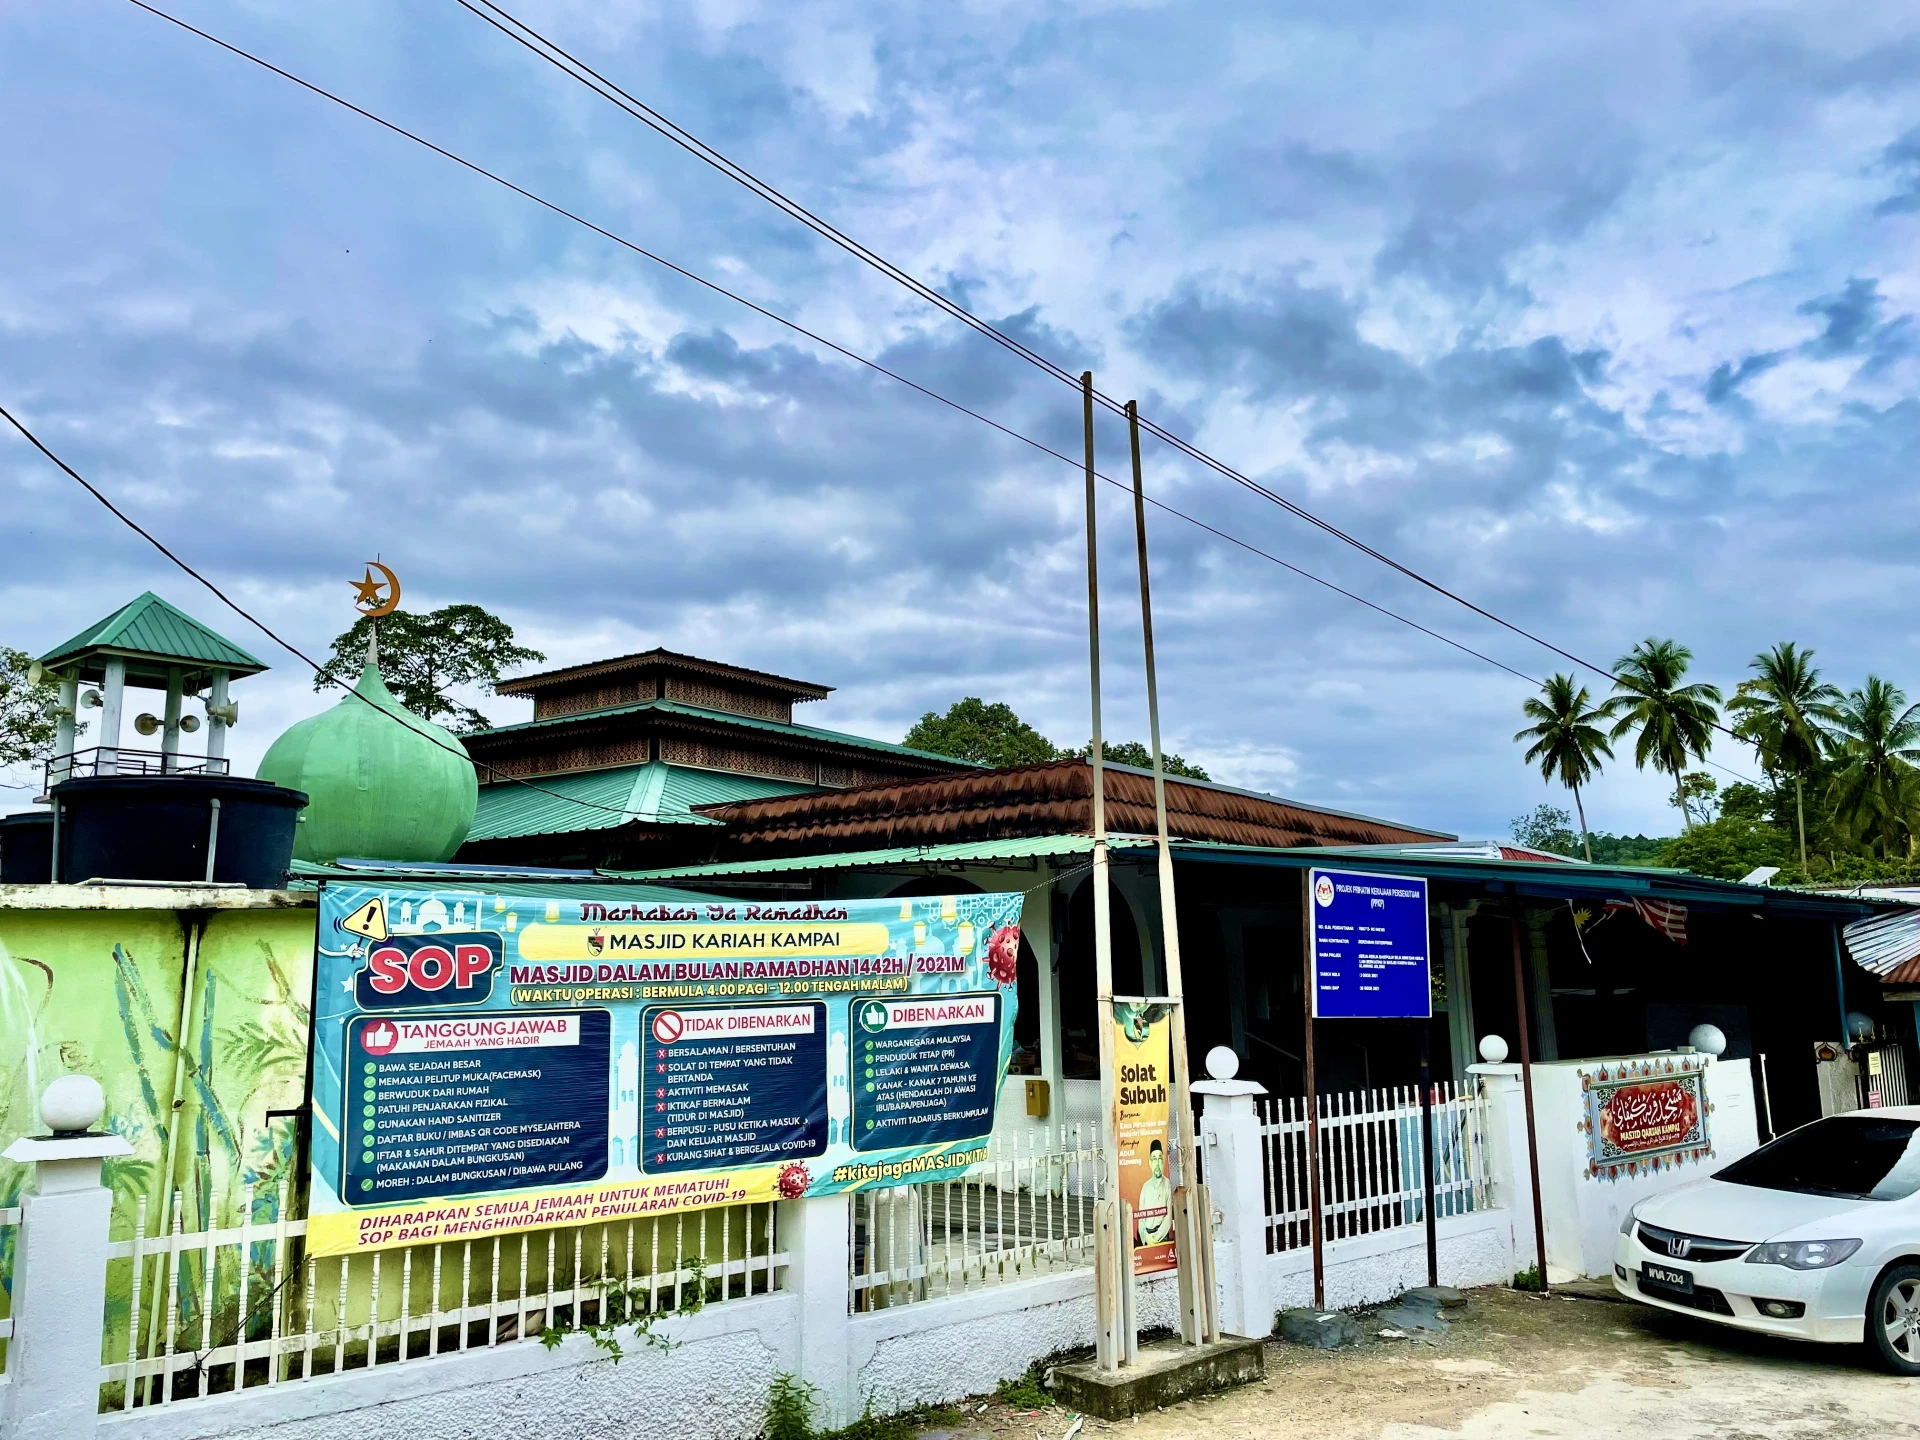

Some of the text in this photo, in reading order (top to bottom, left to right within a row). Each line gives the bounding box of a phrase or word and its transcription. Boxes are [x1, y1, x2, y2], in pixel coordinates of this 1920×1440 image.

[1336, 884, 1353, 894] PROJEK
[1371, 887, 1392, 896] KERAJAAN
[1392, 888, 1420, 898] PERSEKUTUAN
[580, 903, 847, 922] Marhaban Ya Ramadhan
[610, 932, 840, 950] MASJID KARIAH KAMPAI
[370, 944, 493, 993] SOP
[510, 966, 593, 984] MASJID
[597, 964, 671, 982] DALAM
[675, 962, 738, 980] BULAN
[743, 960, 850, 979] RAMADHAN
[853, 958, 903, 975] 1442H
[917, 956, 965, 973] 2021M
[510, 977, 908, 1006] (WAKTU OPERASI BERMULA 4.00 PAGI 12.00 TENGAH MALAM)
[893, 1004, 985, 1023] DIBENARKAN
[401, 1020, 567, 1039] TANGGUNGJAWAB
[684, 1014, 811, 1032] TIDAK DIBENARKAN
[424, 1036, 540, 1049] JEMAAH YANG HADIR
[668, 1042, 796, 1058] BERSALAMAN BERSENTUHAN
[875, 1034, 971, 1049] WARGANEGARA MALAYSIA
[668, 1056, 793, 1072] SOLAT DI TEMPAT YANG TIDAK
[875, 1049, 955, 1063] PENDUDUK TETAP (PR)
[379, 1060, 481, 1073] BAWA SEJADAH BESAR
[876, 1067, 903, 1077] LELAKI
[911, 1064, 939, 1074] WANITA
[940, 1062, 970, 1071] DEWASA
[1121, 1064, 1157, 1083] Solat
[378, 1070, 542, 1087] MEMAKAI PELITUP MUKA(FACEMASK)
[668, 1073, 713, 1084] BERTANDA
[876, 1074, 977, 1091] KANAK KANAK 7 TAHUN KE
[378, 1086, 489, 1100] BERWUDUK DARI RUMAH
[668, 1083, 749, 1097] AKTIVITI MEMASAK
[876, 1085, 976, 1102] ATAS (HENDAKLAH DI AWASI
[1120, 1084, 1166, 1106] Subuh
[378, 1098, 508, 1114] PATUHI PENJARAKAN FIZIKAL
[668, 1096, 751, 1111] IKTIKAF BERMALAM
[876, 1098, 947, 1113] IBU/BAPA/PENJAGA)
[377, 1113, 501, 1130] GUNAKAN HAND SANITIZER
[667, 1109, 744, 1125] (TIDUR DI MASJID)
[876, 1107, 989, 1128] AKTIVITI TADARUS BERKUMPULAN
[377, 1121, 581, 1145] DAFTAR BUKU IMBAS QR CODE MYSEJAHTERA
[667, 1117, 800, 1136] BERPUSU PUSU KETIKA MASUK
[1620, 1123, 1681, 1141] MASJID QARIAH KAMPAI
[377, 1136, 570, 1161] IFTAR & SAHUR DITEMPAT YANG DISEDIAKAN
[667, 1133, 756, 1149] DAN KELUAR MASJID
[667, 1140, 816, 1162] KURANG SIHAT & BERGEJALA COVID-19
[376, 1152, 525, 1175] (MAKANAN DALAM BUNGKUSAN)
[376, 1161, 583, 1189] MOREH DALAM BUNGKUSAN DIBAWA PULANG
[359, 1179, 730, 1230] DIHARAPKAN SEMUA JEMAAH UNTUK MEMATUHI
[358, 1190, 746, 1246] SOP BAGI MENGHINDARKAN PENULARAN COVID-19
[1649, 1268, 1684, 1285] WVA 704
